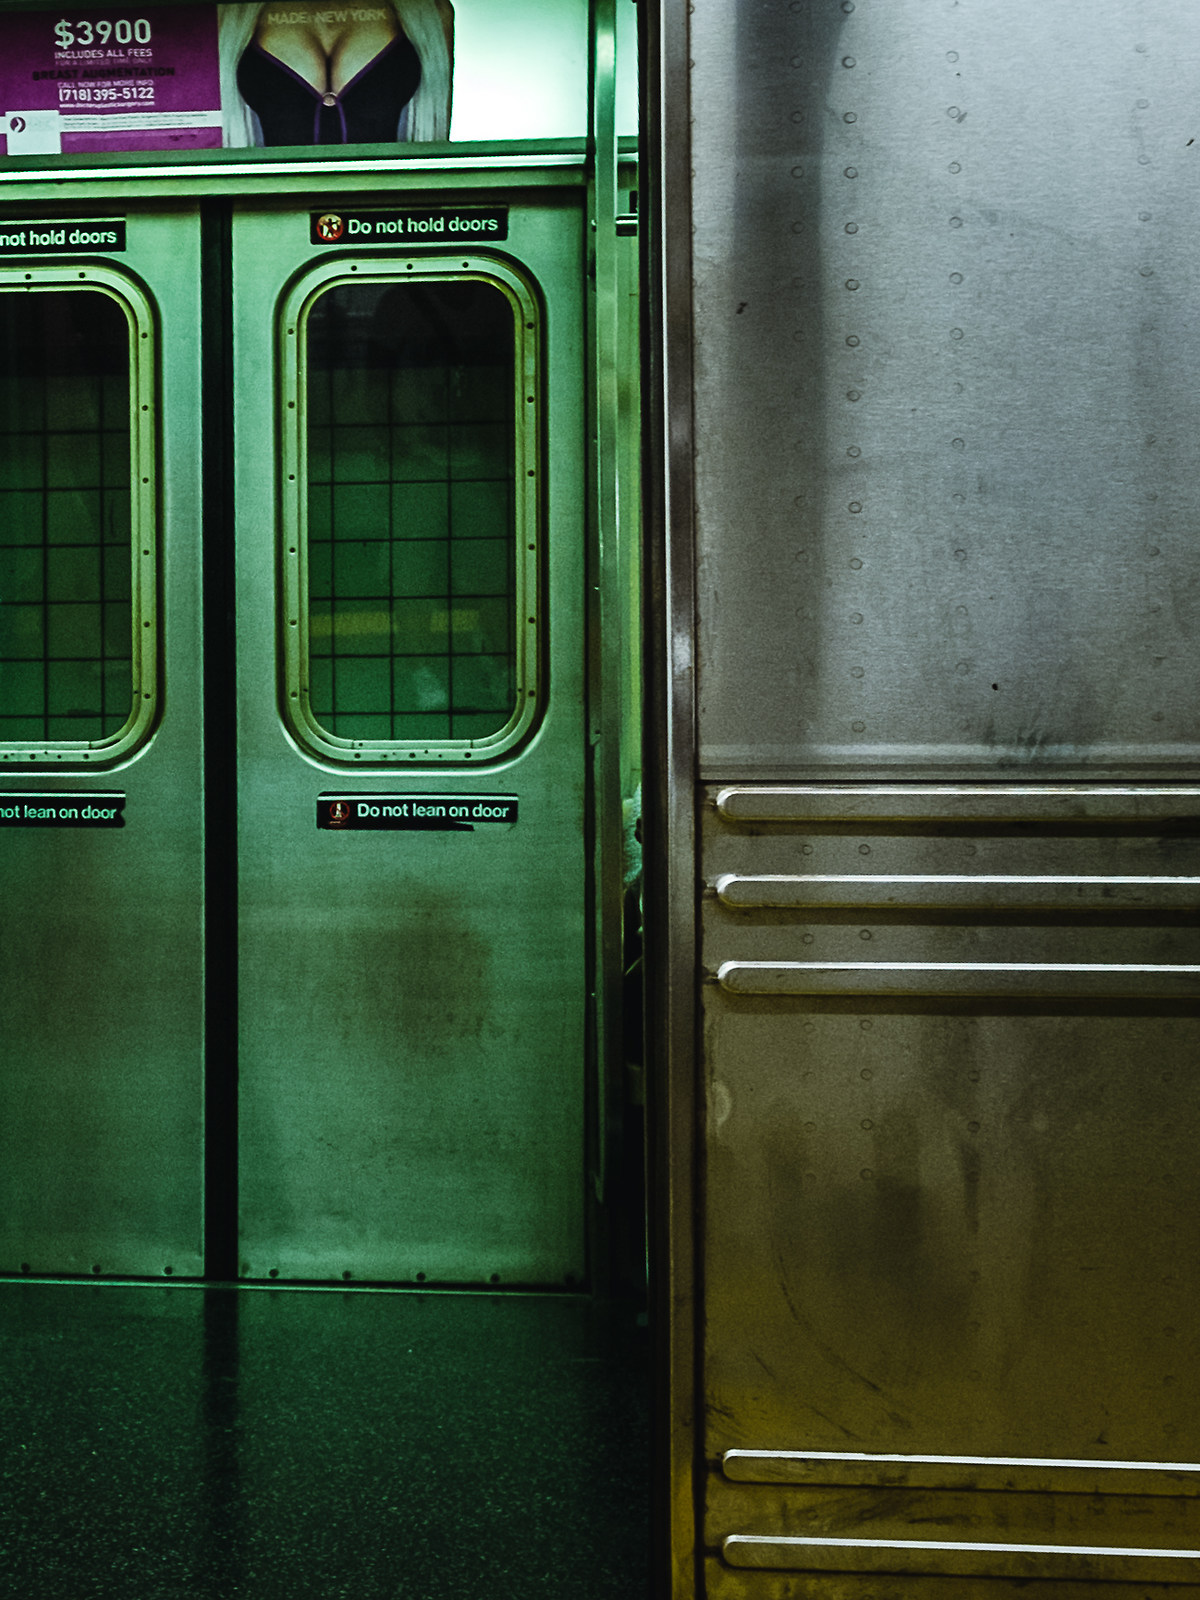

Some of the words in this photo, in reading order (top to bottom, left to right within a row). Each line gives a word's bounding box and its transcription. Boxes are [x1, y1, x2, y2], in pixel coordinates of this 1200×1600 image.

[267, 11, 309, 24] MADE
[315, 10, 349, 22] NEW
[350, 8, 386, 20] YORK
[54, 18, 151, 49] $3900
[54, 50, 104, 59] INCLUDES
[106, 49, 125, 58] ALL
[127, 48, 153, 57] FEES
[32, 69, 79, 81] BREAST
[81, 67, 175, 78] AUGMENTATION
[59, 88, 91, 101] (718)
[93, 87, 154, 101] 395-5122
[348, 219, 372, 234] Do
[376, 219, 404, 233] not
[407, 217, 444, 232] hold
[448, 216, 498, 231] doors
[0, 232, 26, 246] not
[29, 230, 65, 246] hold
[69, 229, 117, 244] doors
[24, 804, 56, 818] lean
[59, 808, 78, 819] on
[81, 805, 117, 819] door
[357, 803, 380, 817] Do
[382, 804, 408, 817] not
[412, 803, 446, 817] lean
[449, 807, 470, 817] on
[472, 804, 509, 817] door
